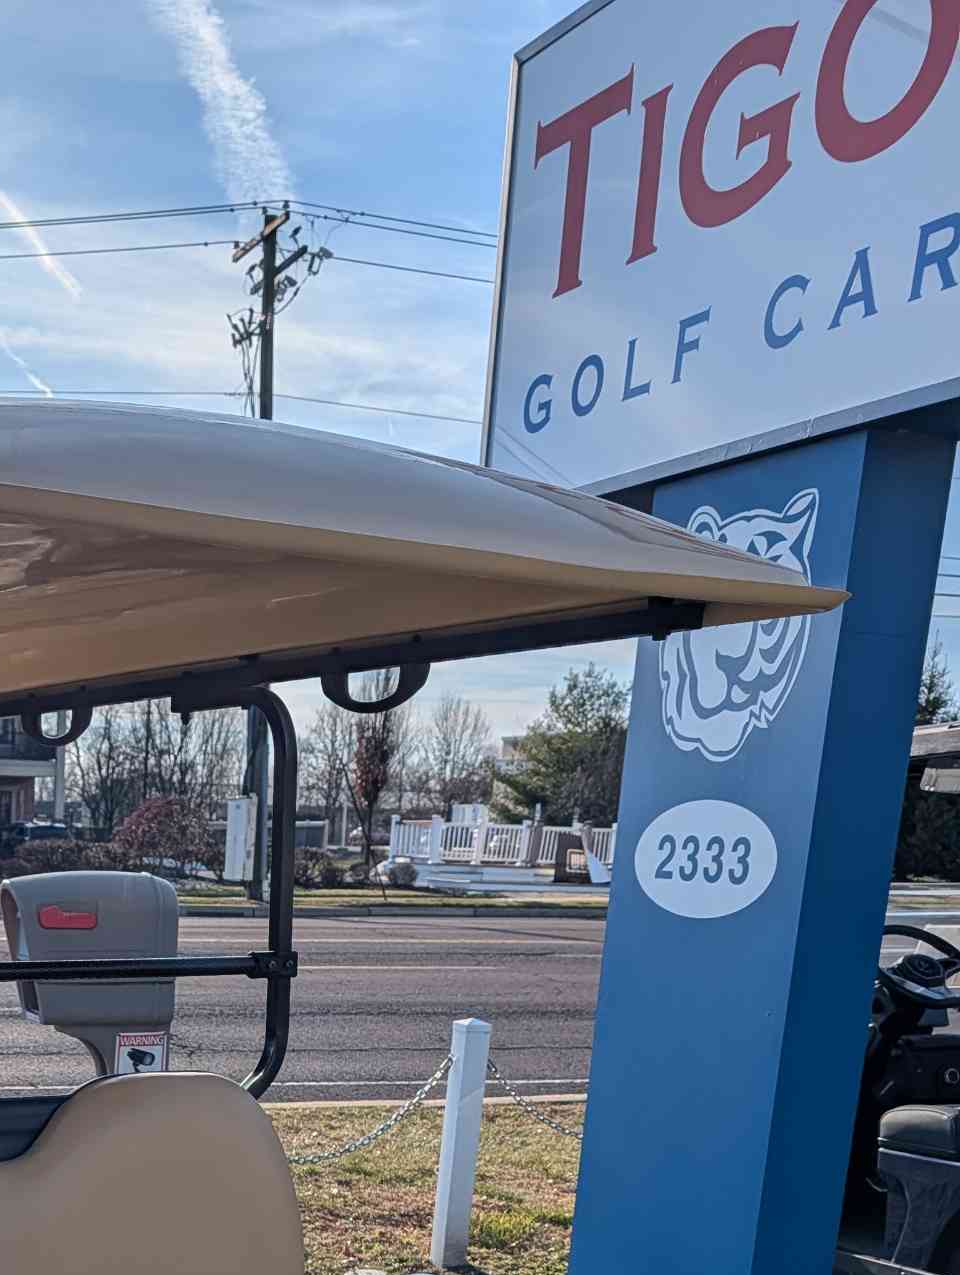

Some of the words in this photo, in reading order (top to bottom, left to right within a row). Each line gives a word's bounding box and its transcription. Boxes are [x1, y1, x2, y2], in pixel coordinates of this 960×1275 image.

[534, 0, 960, 299] TIGO
[523, 305, 712, 434] GOLF
[763, 212, 960, 349] CAR
[654, 834, 751, 886] 2333
[120, 1034, 164, 1046] WARNING
